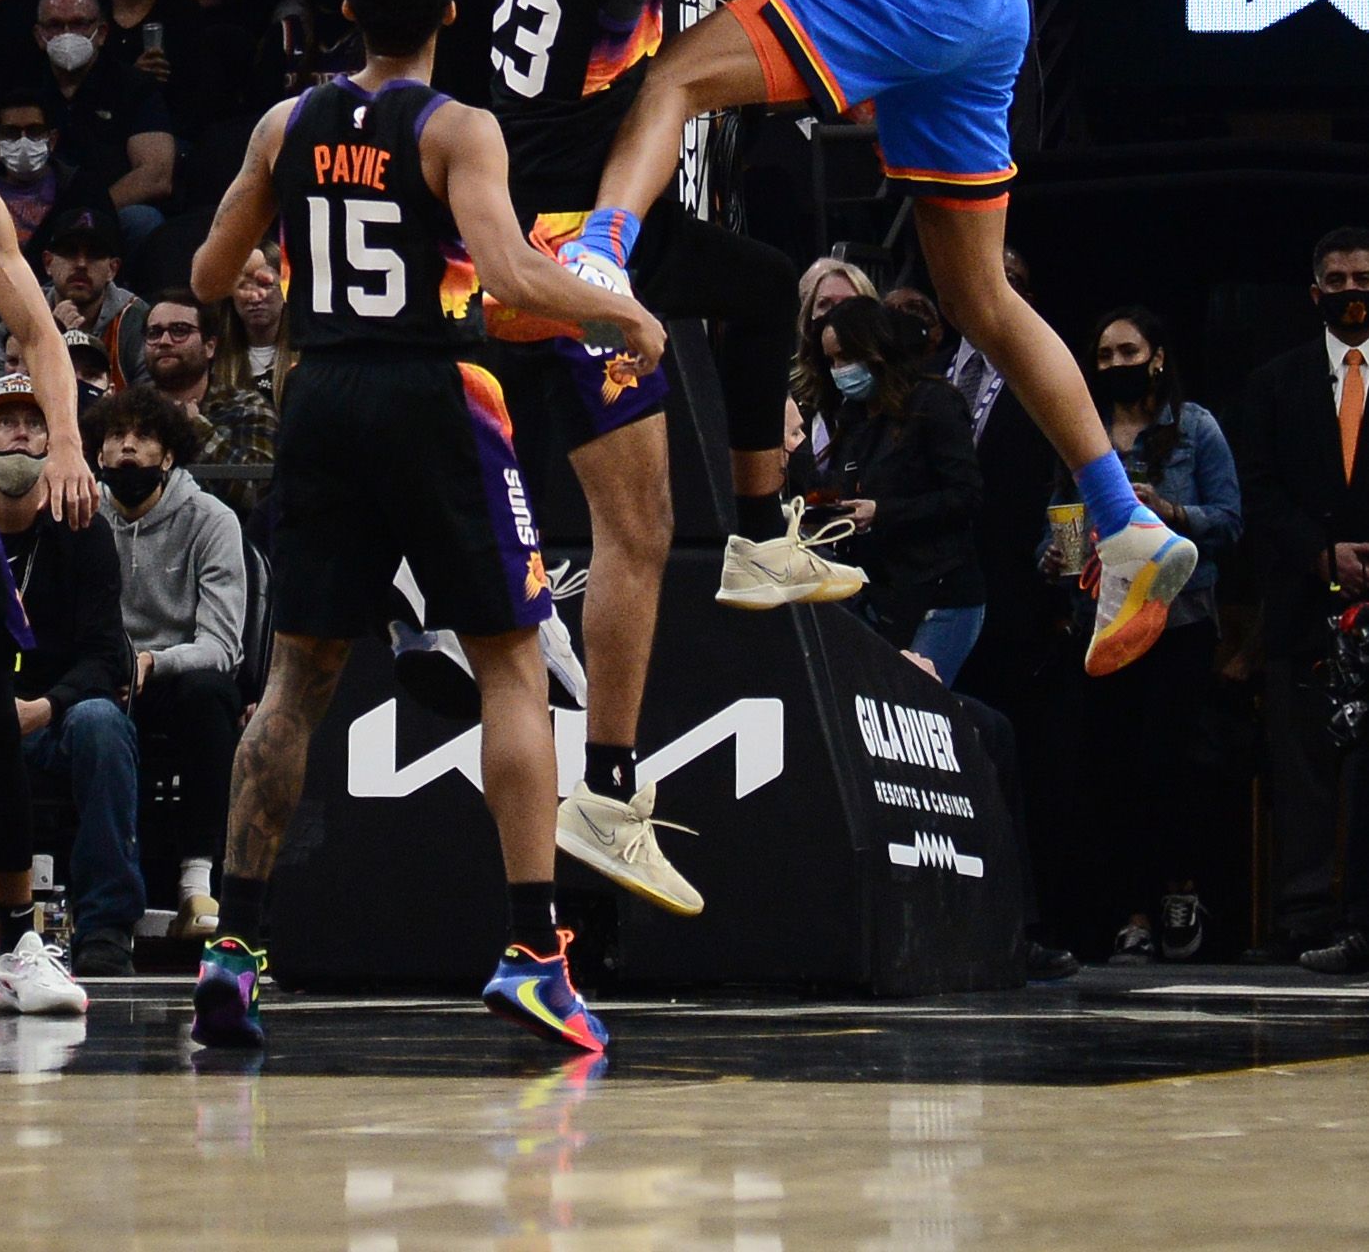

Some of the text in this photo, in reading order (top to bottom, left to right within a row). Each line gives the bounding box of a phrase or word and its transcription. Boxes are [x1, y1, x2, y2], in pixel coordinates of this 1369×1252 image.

[313, 144, 391, 192] PAYNE
[306, 196, 407, 318] 15
[502, 467, 537, 547] SUNS
[854, 693, 962, 774] GILA RIVER
[873, 779, 921, 811] RESORTS
[929, 790, 975, 820] CASINOS
